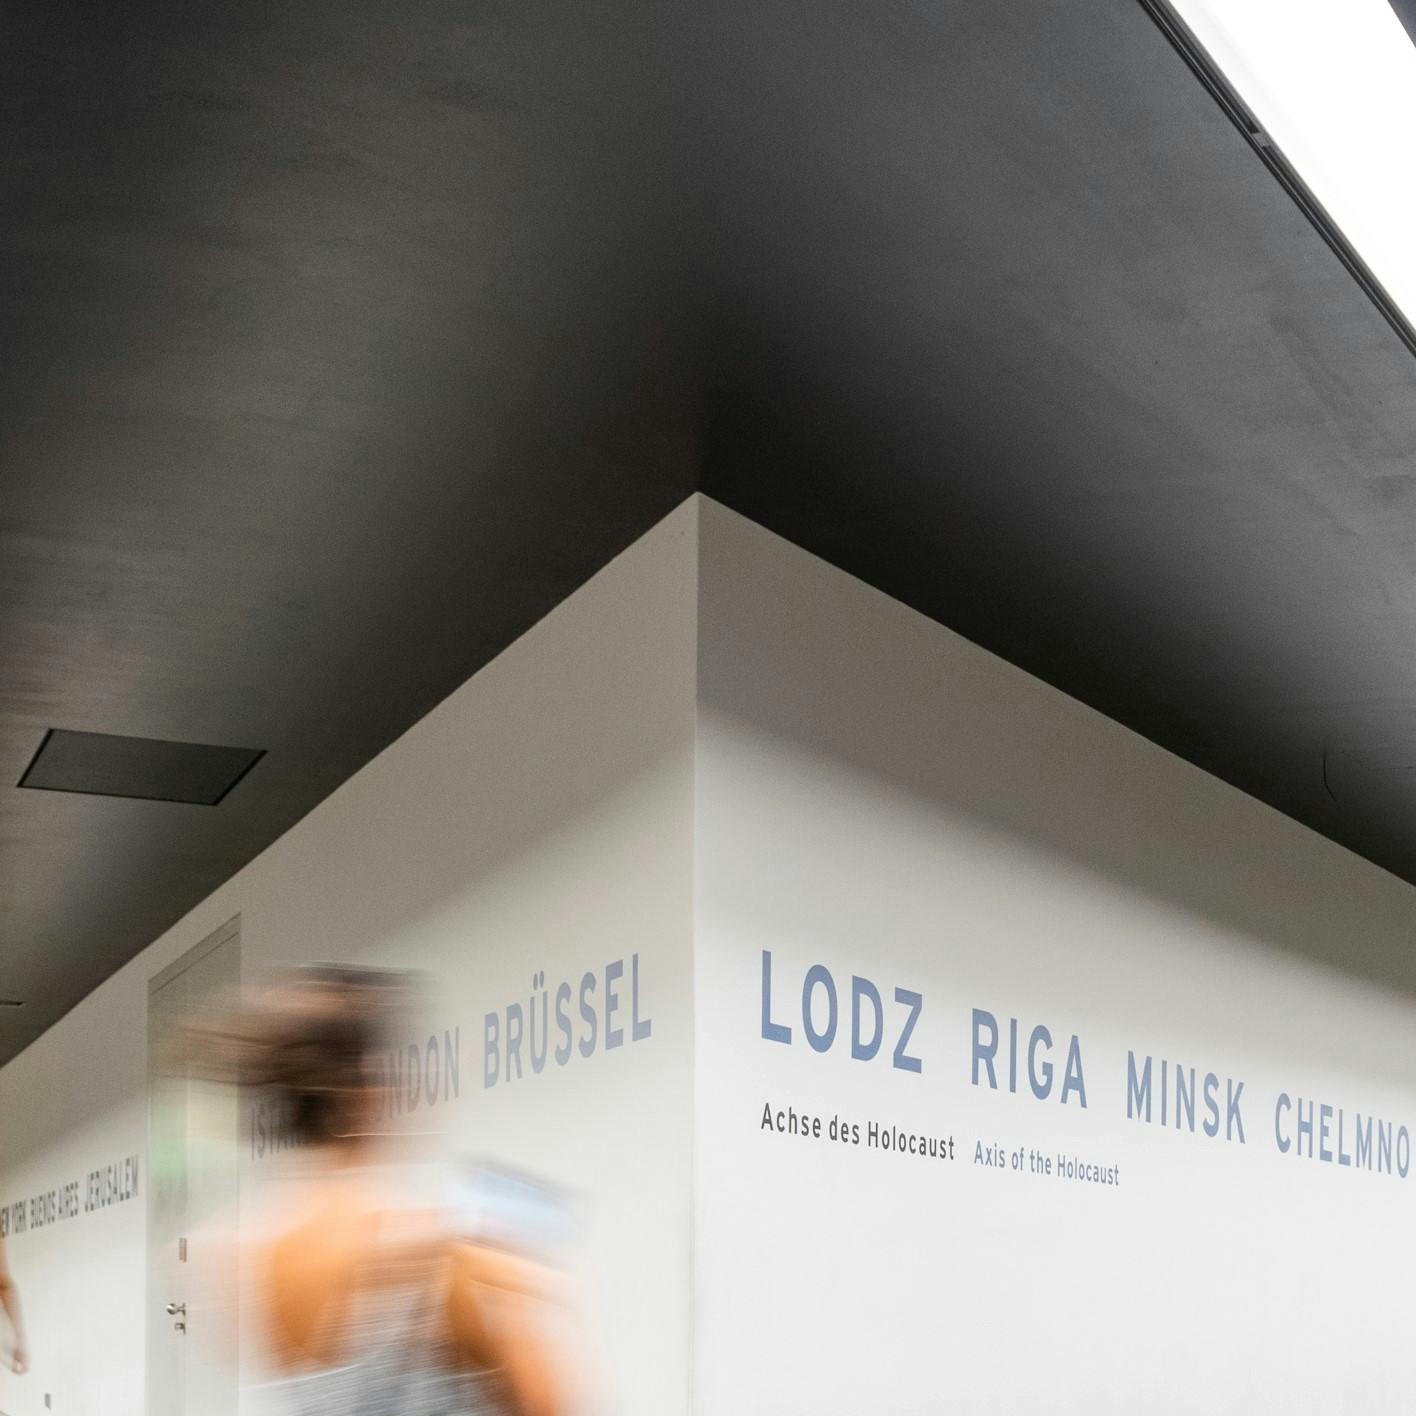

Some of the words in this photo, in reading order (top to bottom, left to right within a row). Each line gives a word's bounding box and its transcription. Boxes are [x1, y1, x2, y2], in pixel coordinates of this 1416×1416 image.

[85, 1154, 139, 1213] JERUSALEM
[484, 953, 652, 1089] BRÜSSEL
[761, 949, 923, 1074] LODZ
[971, 1007, 1088, 1109] RIGA
[1126, 1050, 1246, 1144] MINSK
[1274, 1092, 1410, 1179] CHELMNO
[761, 1102, 821, 1138] Achse
[829, 1113, 860, 1145] des
[868, 1121, 955, 1161] Holocaust
[974, 1140, 1006, 1169] Axis
[1011, 1146, 1026, 1171] of
[1030, 1149, 1052, 1176] the
[1057, 1154, 1120, 1186] Holocaust
